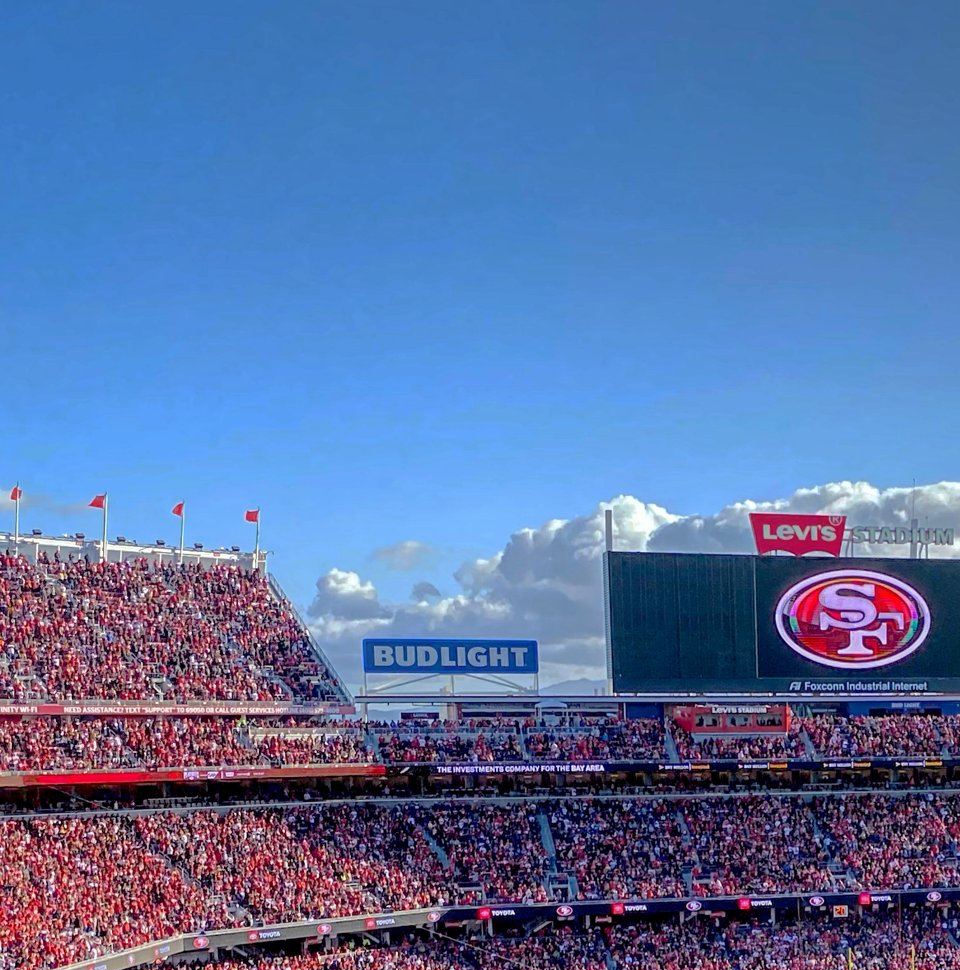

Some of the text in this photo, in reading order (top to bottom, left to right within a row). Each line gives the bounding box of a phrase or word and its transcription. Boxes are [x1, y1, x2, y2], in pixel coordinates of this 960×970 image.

[851, 525, 955, 545] STADIUM
[805, 681, 845, 691] Foxconn
[847, 681, 890, 691] Industrial
[892, 681, 928, 691] Internet
[437, 764, 605, 774] THE INVESTMENTS COMPANY FOR THE BAY AREA
[624, 904, 647, 912] TOYOTA
[492, 909, 515, 917] TOYOTA
[376, 918, 396, 926] TOYOTA
[259, 931, 281, 939] TOYOTA
